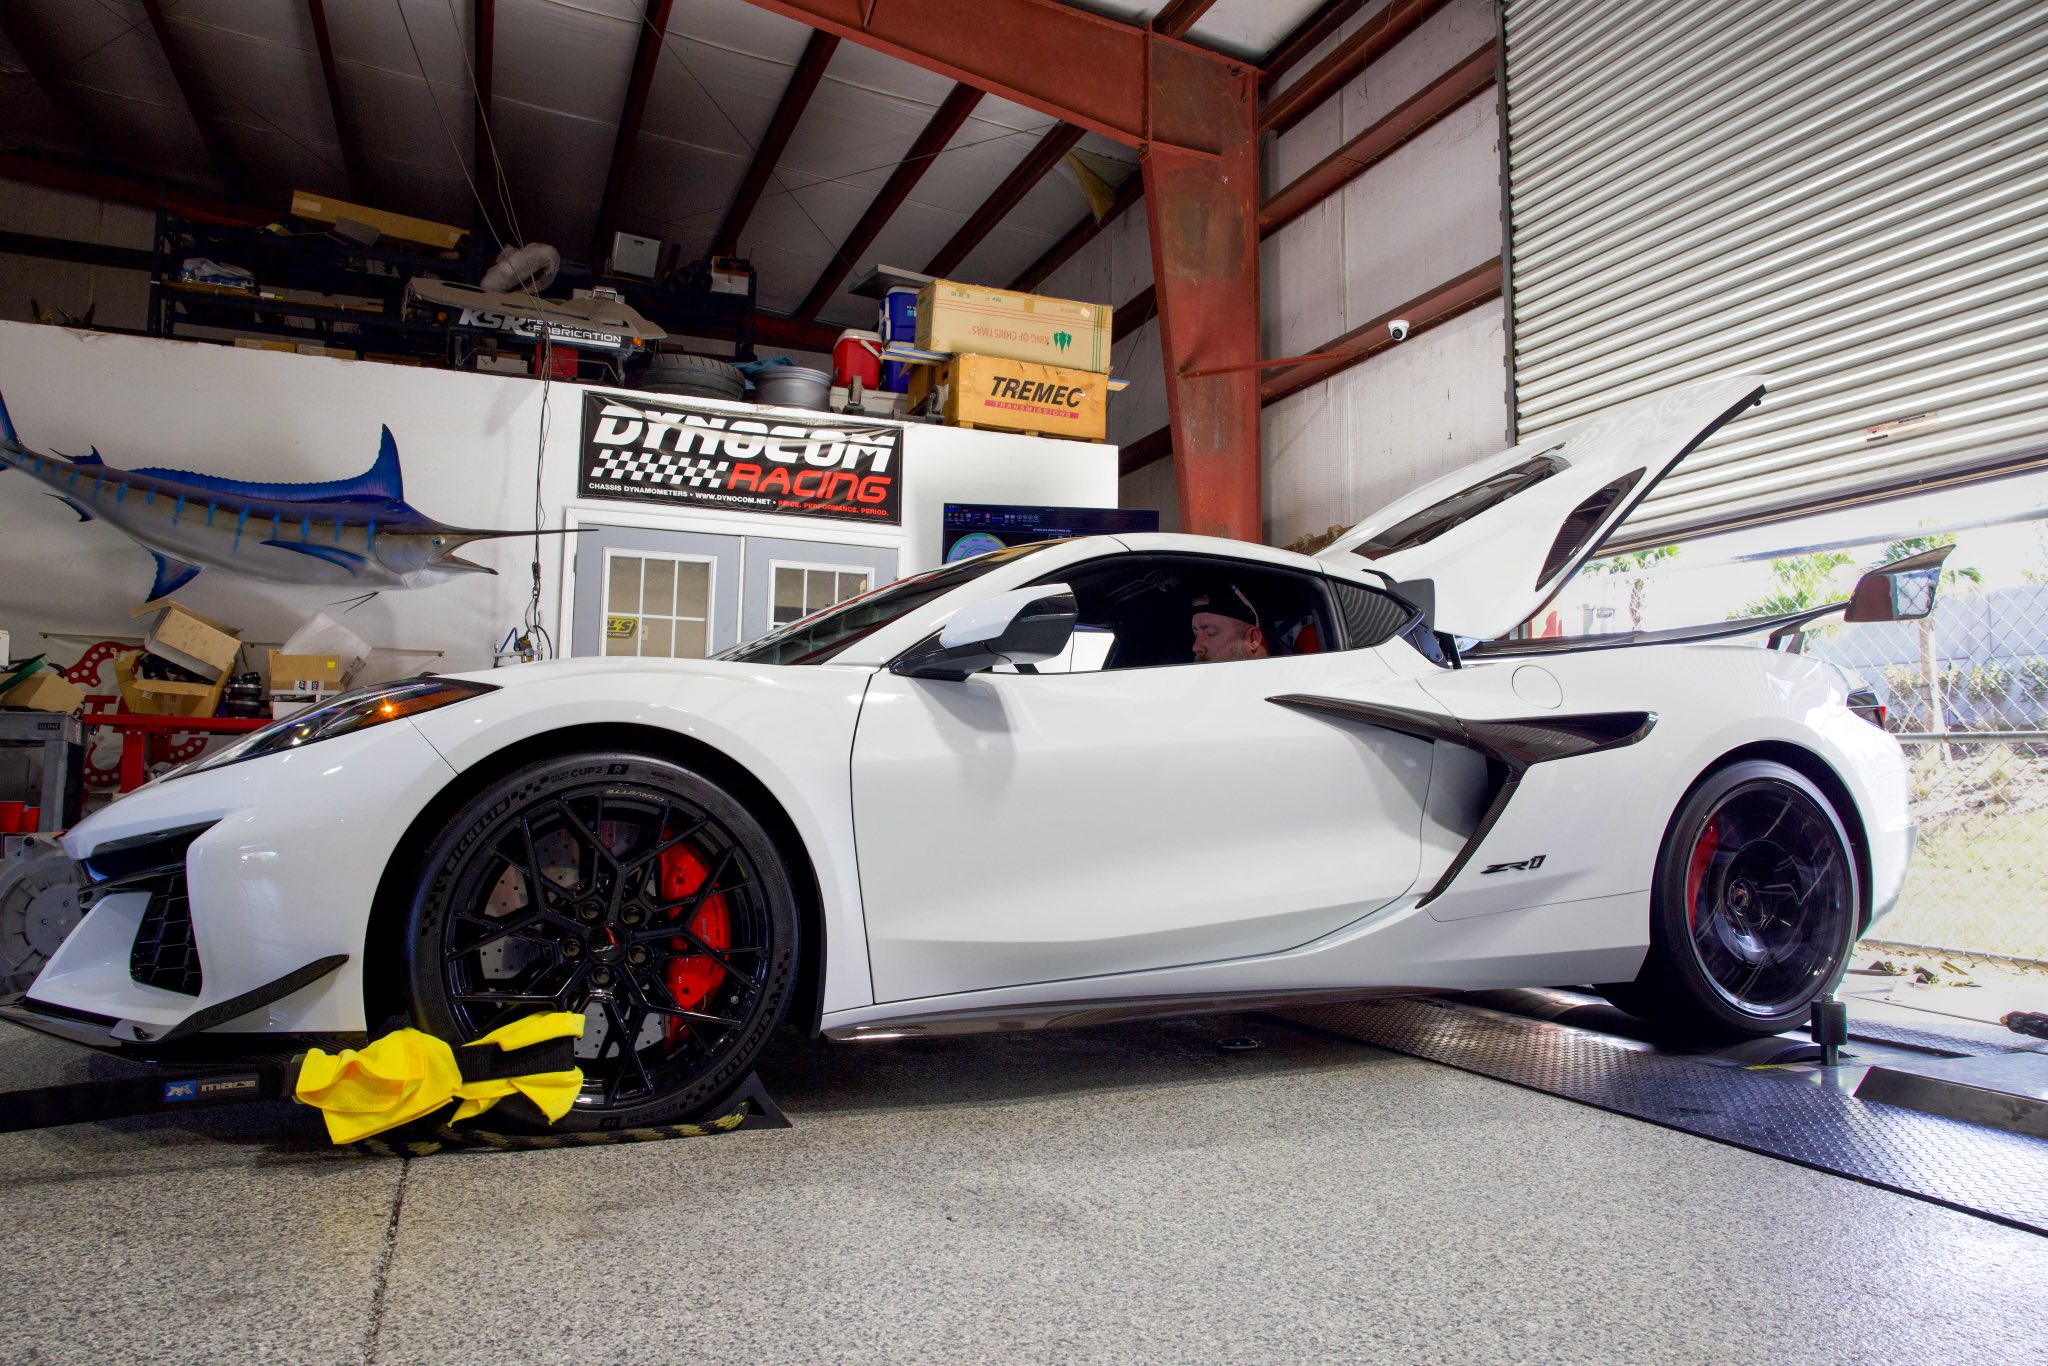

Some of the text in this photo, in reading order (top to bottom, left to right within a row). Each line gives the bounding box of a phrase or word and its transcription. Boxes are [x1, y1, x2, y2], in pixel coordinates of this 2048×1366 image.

[458, 309, 535, 337] KSR
[526, 324, 622, 343] +FBRICATION
[1019, 331, 1029, 343] OF
[991, 376, 1084, 408] TREMEC
[994, 401, 1072, 419] TRANSMISSIONS
[592, 404, 896, 473] DYNOCOM
[588, 482, 622, 492] CHASSIS
[623, 485, 688, 498] DYNAMOMETERS
[695, 492, 772, 505] WWW.DYNOCOM.NET
[803, 502, 859, 513] PERFORMANCE.
[860, 507, 889, 516] PERIOD.
[727, 462, 891, 504] RACING
[445, 799, 509, 874] MICHELIN
[717, 1012, 772, 1082] MICHELIN
